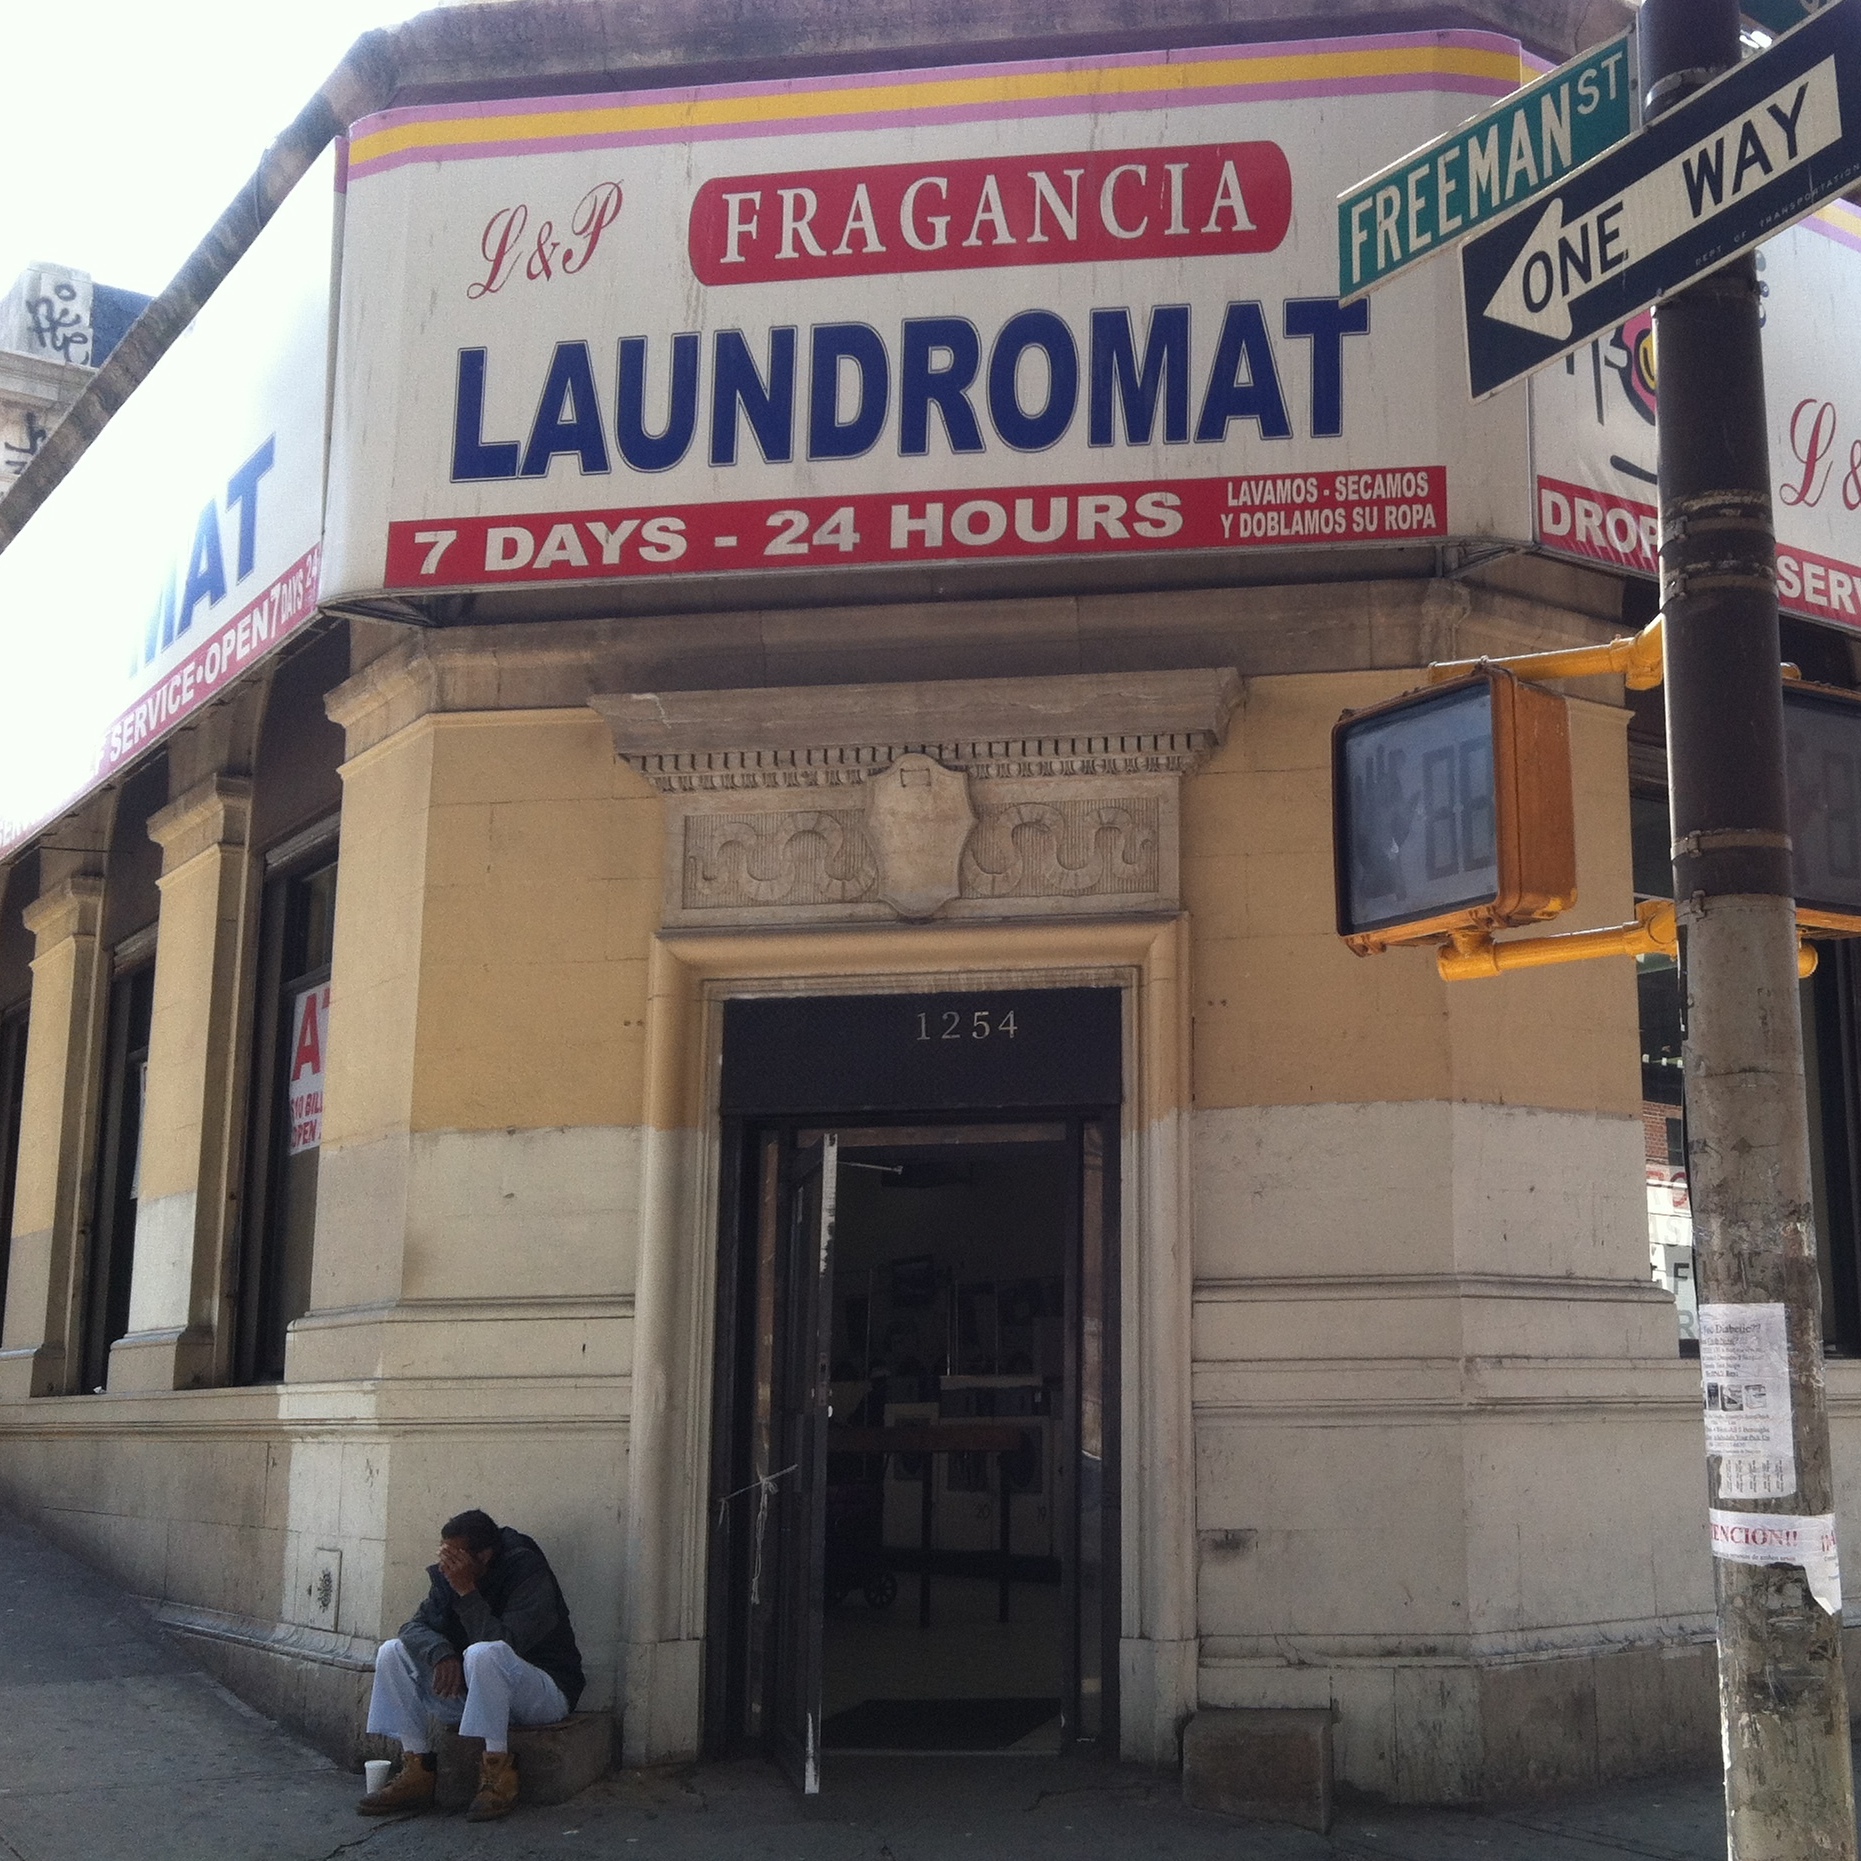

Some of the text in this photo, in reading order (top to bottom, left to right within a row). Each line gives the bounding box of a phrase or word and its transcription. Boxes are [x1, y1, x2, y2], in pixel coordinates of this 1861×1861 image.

[720, 160, 1257, 263] FRAGANCIA
[1351, 51, 1623, 284] FREEMAN ST
[1522, 82, 1810, 313] ONE WAY
[1733, 230, 1747, 244] OF
[1759, 162, 1861, 228] TRANSPORTATION
[451, 296, 1371, 483] LAUNDROMAT
[414, 530, 458, 575] 7
[484, 517, 688, 572] DAYS
[764, 507, 861, 556] 24
[890, 492, 1184, 549] HOURS
[1220, 501, 1437, 539] Y DOBLAMOS SU ROPA
[1227, 478, 1318, 506] LAVAMOS
[1335, 471, 1430, 502] SECAMOS
[109, 664, 197, 762] SERVICE
[204, 598, 269, 684] OPEN
[916, 1010, 1018, 1040] 1254
